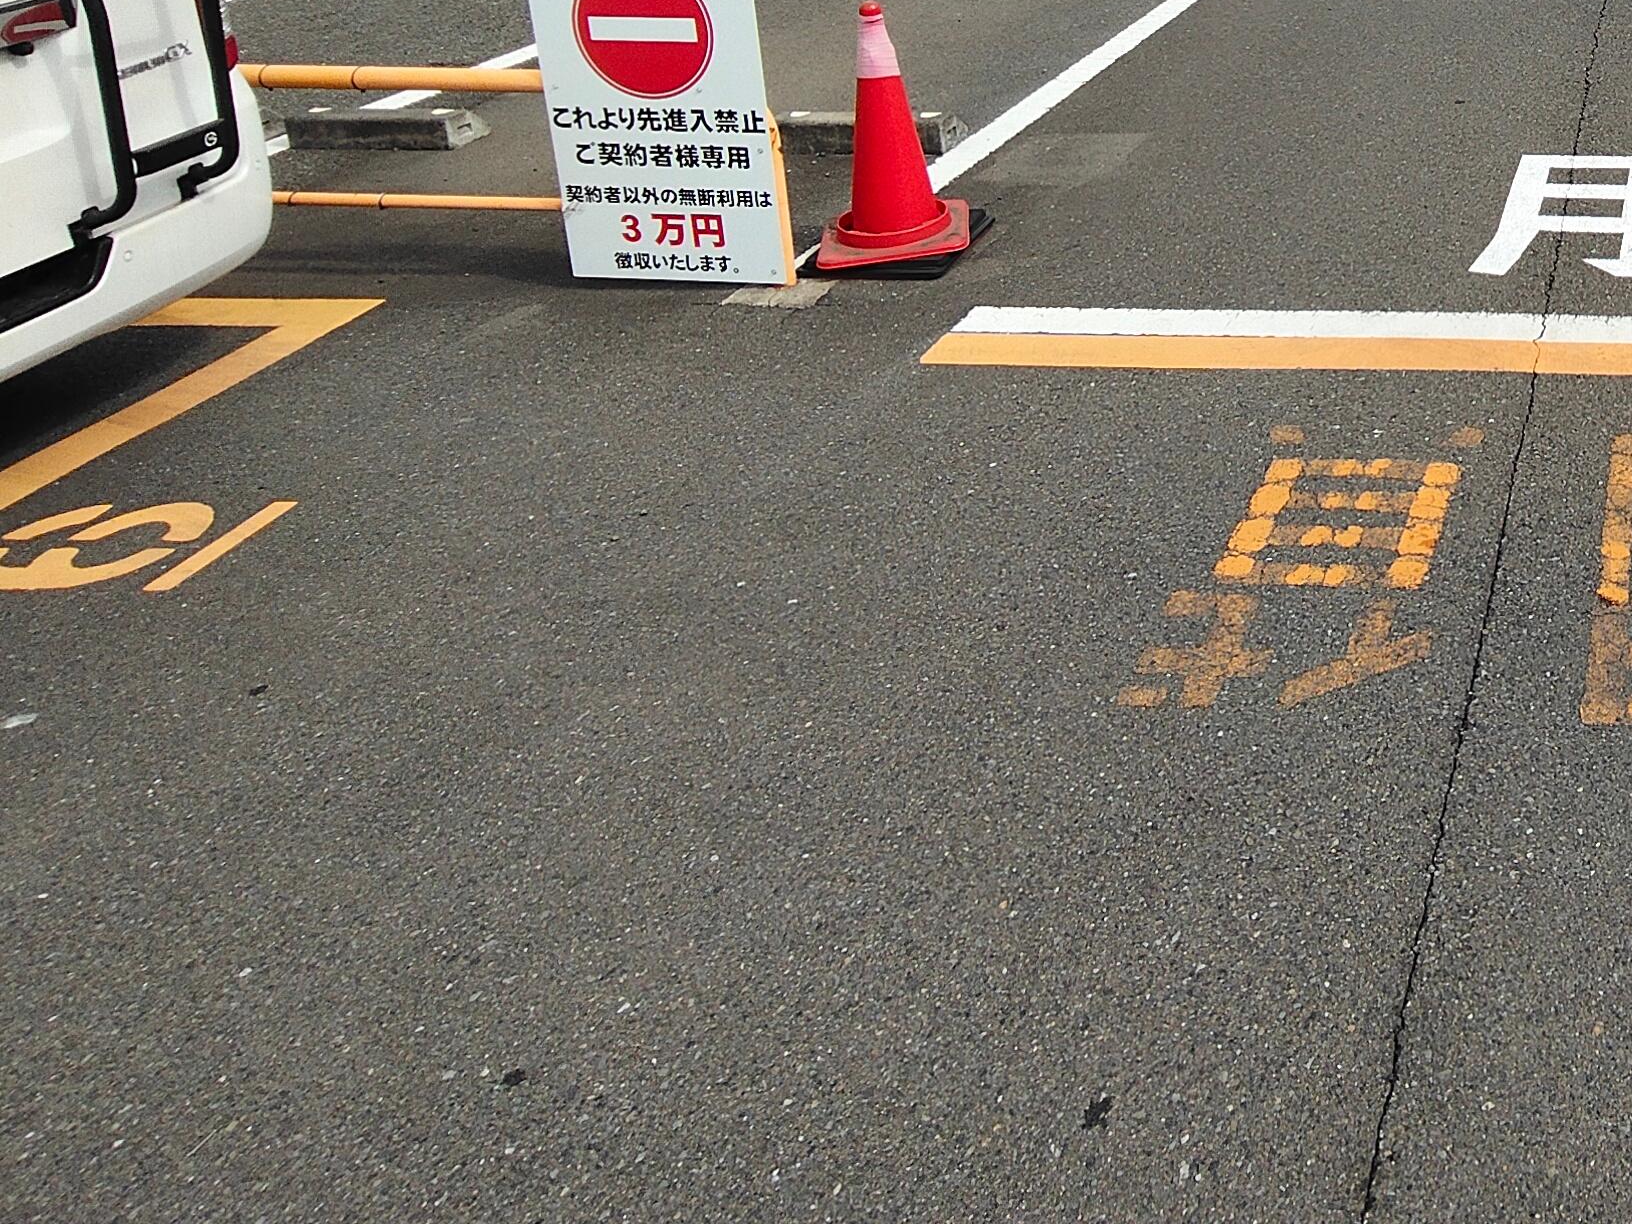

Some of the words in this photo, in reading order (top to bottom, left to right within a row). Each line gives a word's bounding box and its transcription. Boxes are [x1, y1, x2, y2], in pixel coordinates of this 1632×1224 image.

[552, 106, 766, 135] これより先進入禁止
[575, 142, 751, 170] ご契約者様専用
[565, 185, 773, 208] 契約者以外の無断利用は
[620, 213, 726, 248] 3万円
[614, 252, 740, 274] 徴収いたします。
